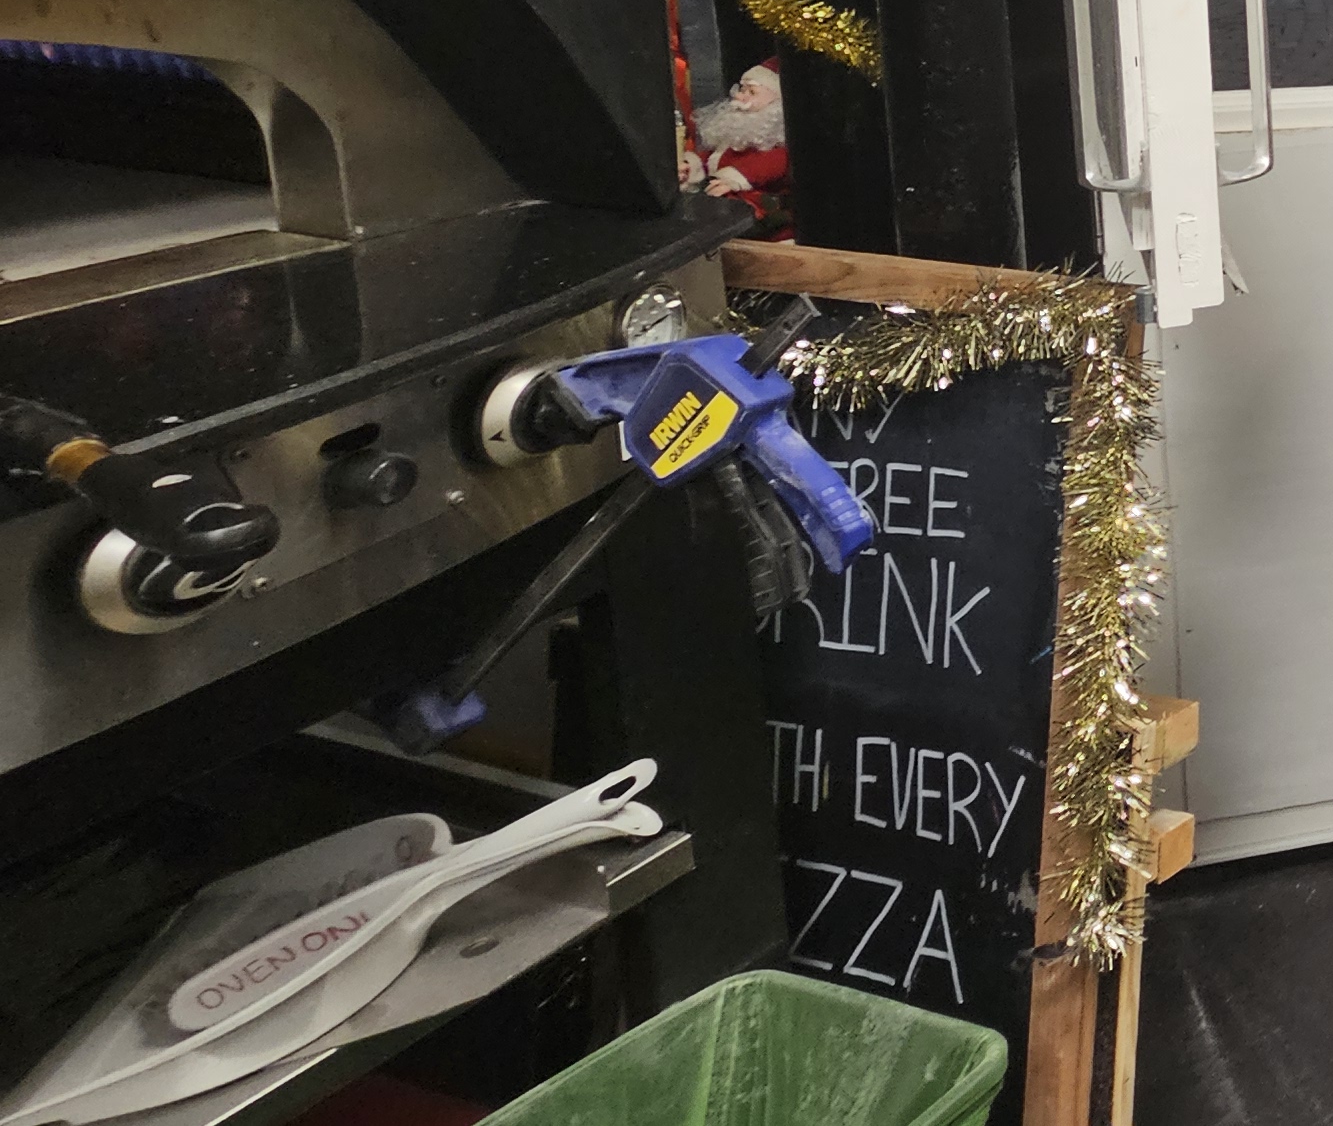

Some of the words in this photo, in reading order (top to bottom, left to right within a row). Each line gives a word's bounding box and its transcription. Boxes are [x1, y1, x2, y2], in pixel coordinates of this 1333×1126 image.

[649, 391, 702, 451] IRWIN
[828, 457, 969, 538] REE
[755, 541, 991, 675] RINK
[854, 736, 1026, 859] EVERY
[195, 945, 297, 1010] OVEN
